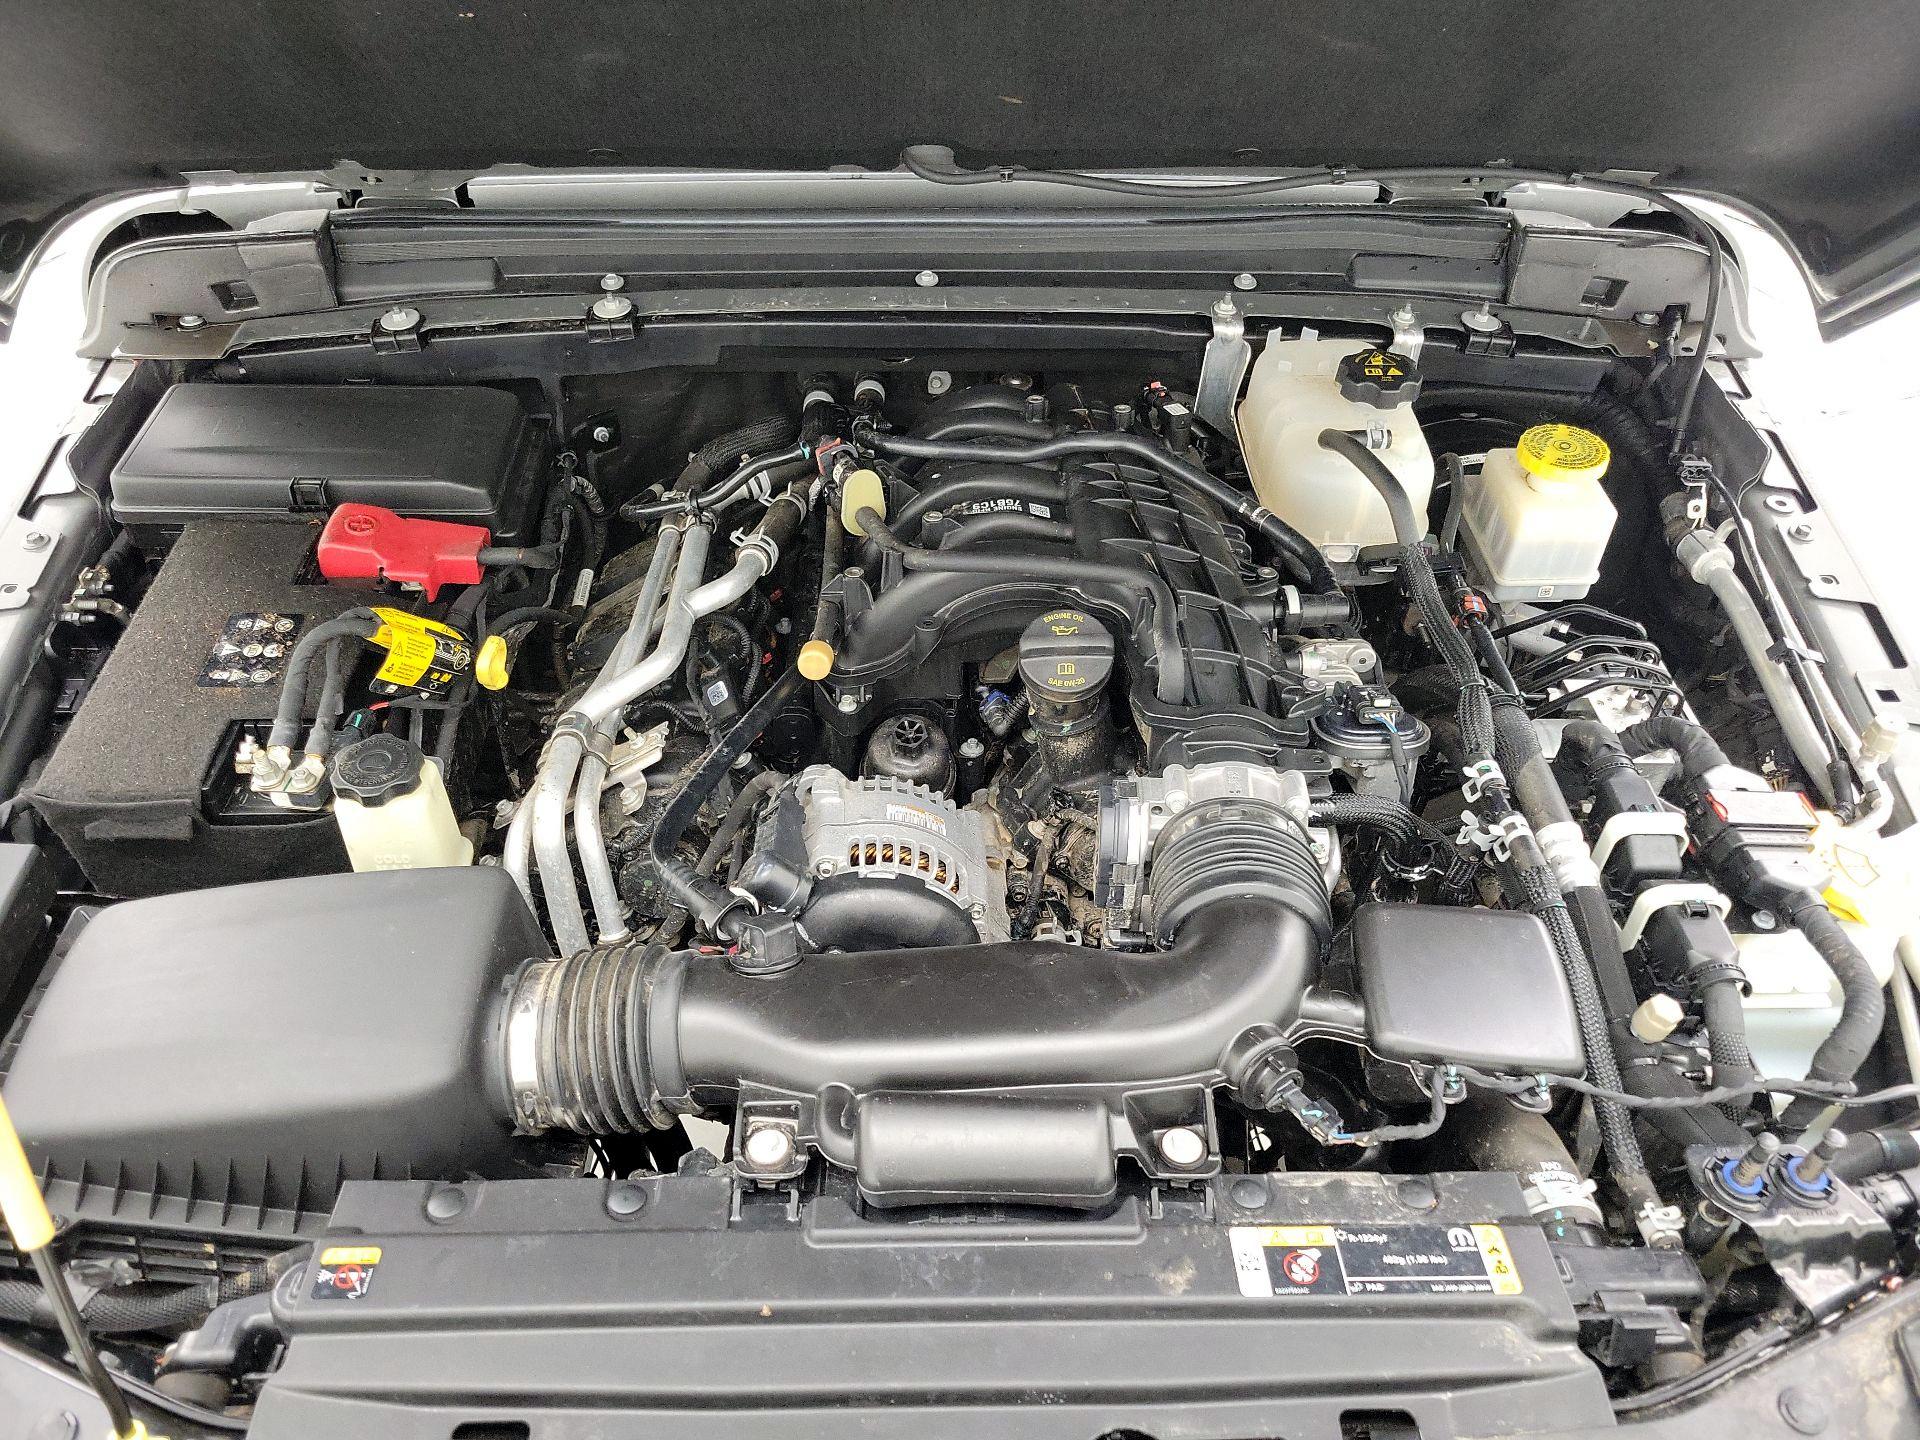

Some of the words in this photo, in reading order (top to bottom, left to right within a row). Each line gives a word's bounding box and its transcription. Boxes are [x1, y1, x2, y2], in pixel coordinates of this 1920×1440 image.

[1043, 612, 1071, 623] ENGINE
[1072, 613, 1085, 623] OIL
[1047, 677, 1063, 687] SAE
[1063, 677, 1086, 687] 0W-20
